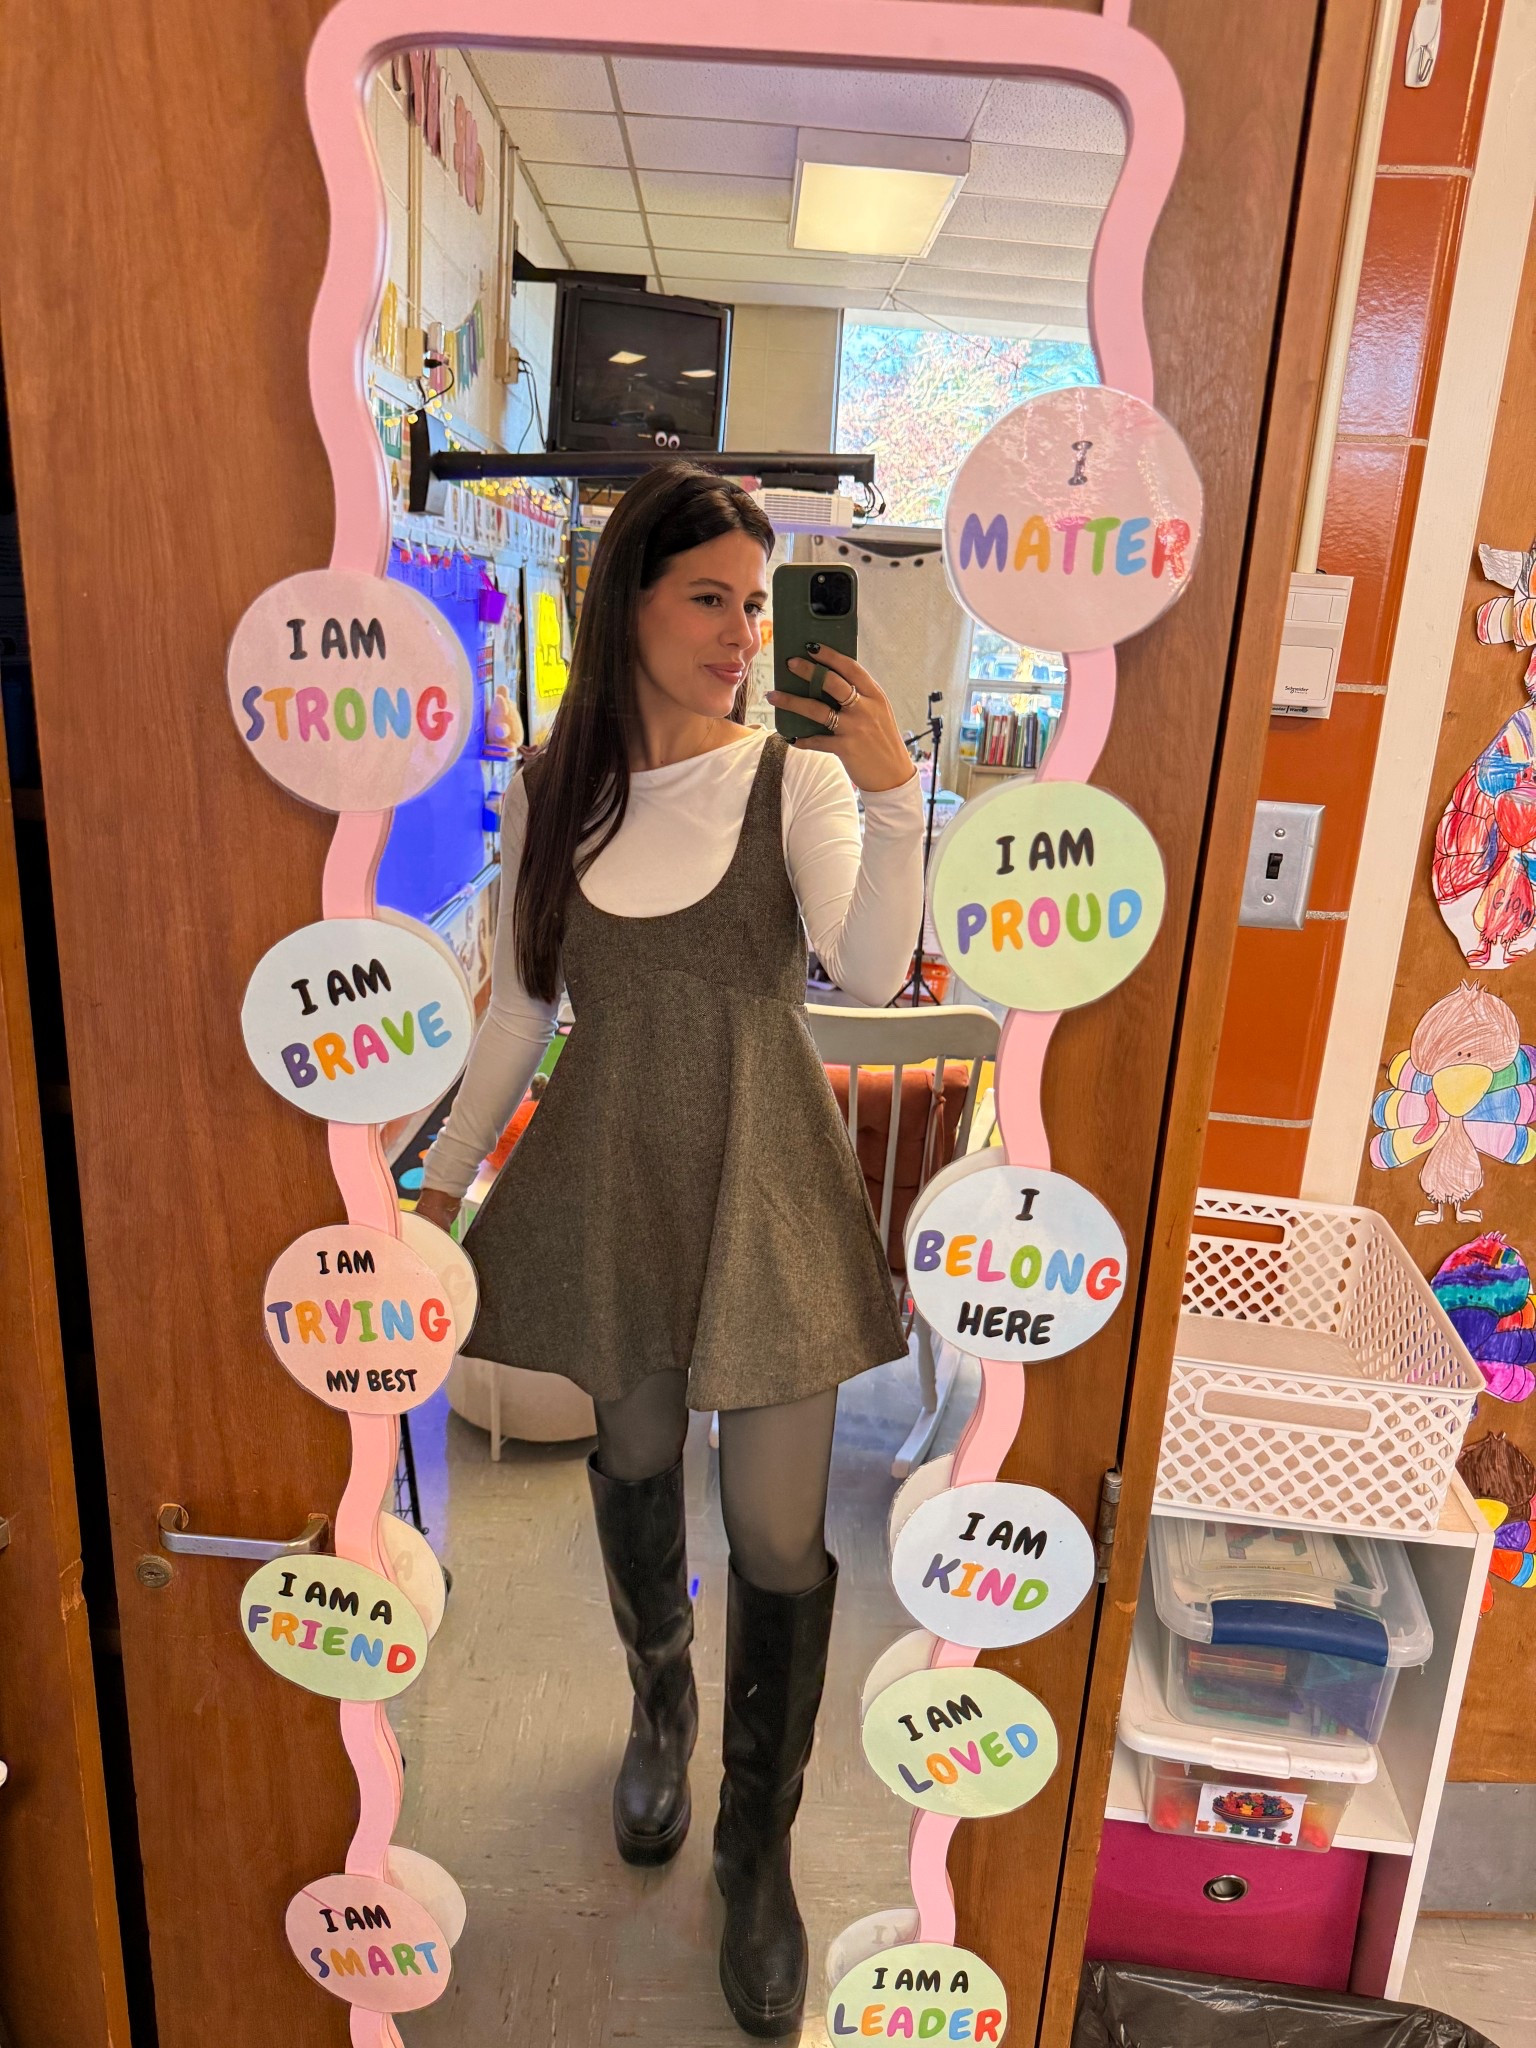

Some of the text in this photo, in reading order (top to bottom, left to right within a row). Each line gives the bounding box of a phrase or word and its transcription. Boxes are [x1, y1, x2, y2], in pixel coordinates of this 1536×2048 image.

[1067, 440, 1093, 486] I
[959, 513, 1191, 579] MATTER
[286, 617, 386, 660] I AM
[242, 685, 454, 742] STRONG
[995, 827, 1095, 876] I AM
[957, 888, 1143, 955] PROUD
[291, 958, 392, 1016] I AM
[281, 1001, 452, 1088] BRAVE
[1015, 1187, 1040, 1221] I
[316, 1249, 375, 1275] I AM
[913, 1229, 1122, 1301] BELONG
[266, 1298, 452, 1344] TRYING
[956, 1301, 1055, 1346] HERE
[326, 1368, 418, 1393] MY BEST
[958, 1512, 1048, 1560] I AM
[278, 1571, 393, 1625] I AM A
[921, 1553, 1049, 1611] KIND
[247, 1604, 417, 1674] FRIEND
[897, 1694, 983, 1742] I AM
[897, 1723, 1039, 1794] LOVED
[318, 1904, 392, 1933] I AM
[310, 1941, 439, 1979] SMART
[871, 1967, 969, 1994] I AM A
[833, 2002, 1002, 2043] LEADER
